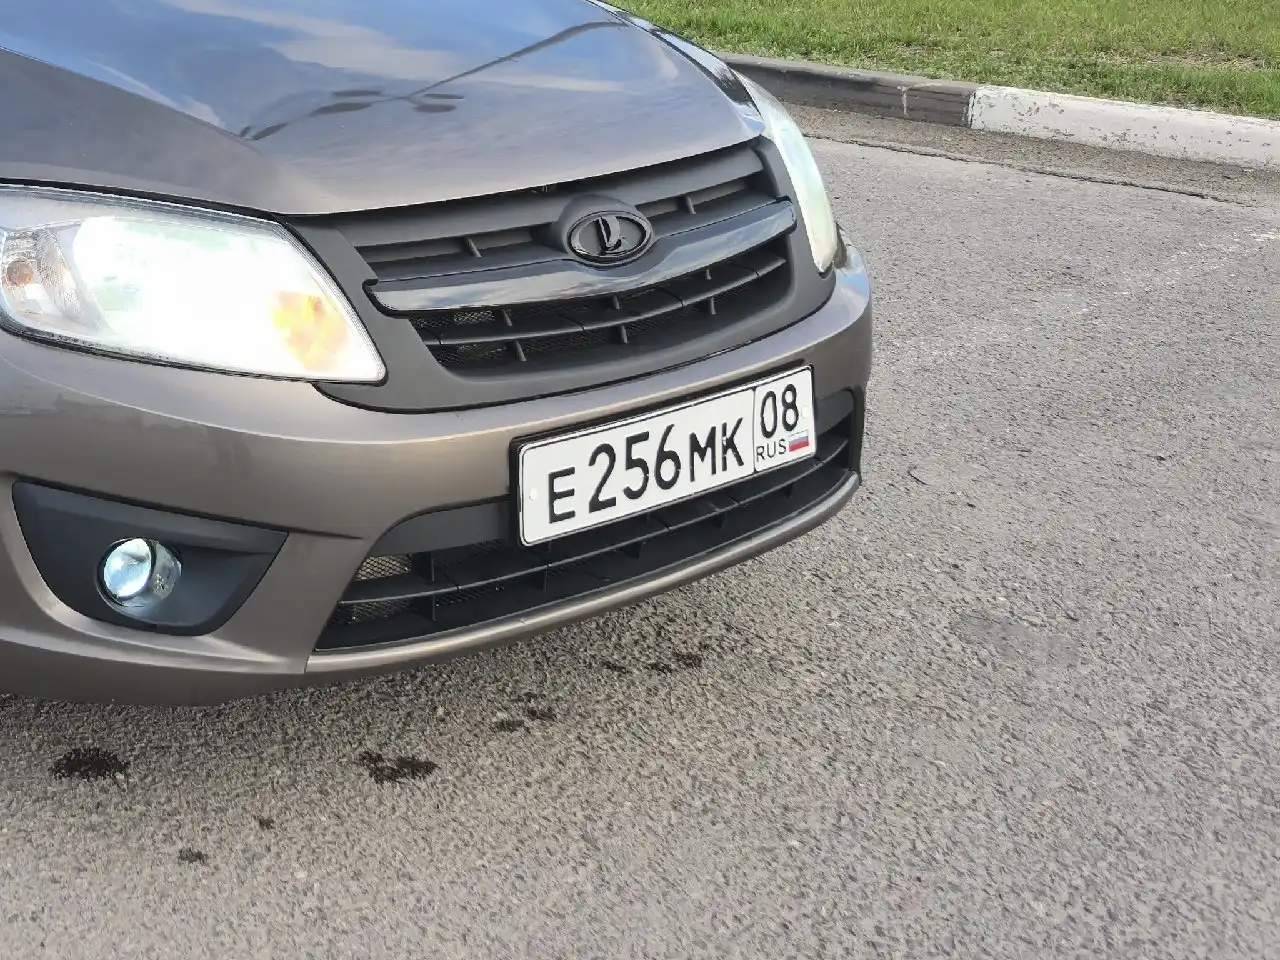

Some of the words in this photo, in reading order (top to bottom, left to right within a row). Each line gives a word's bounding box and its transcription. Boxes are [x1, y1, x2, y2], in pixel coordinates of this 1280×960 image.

[548, 417, 744, 524] Е256МК
[760, 383, 800, 439] 08
[756, 438, 788, 462] RUS
